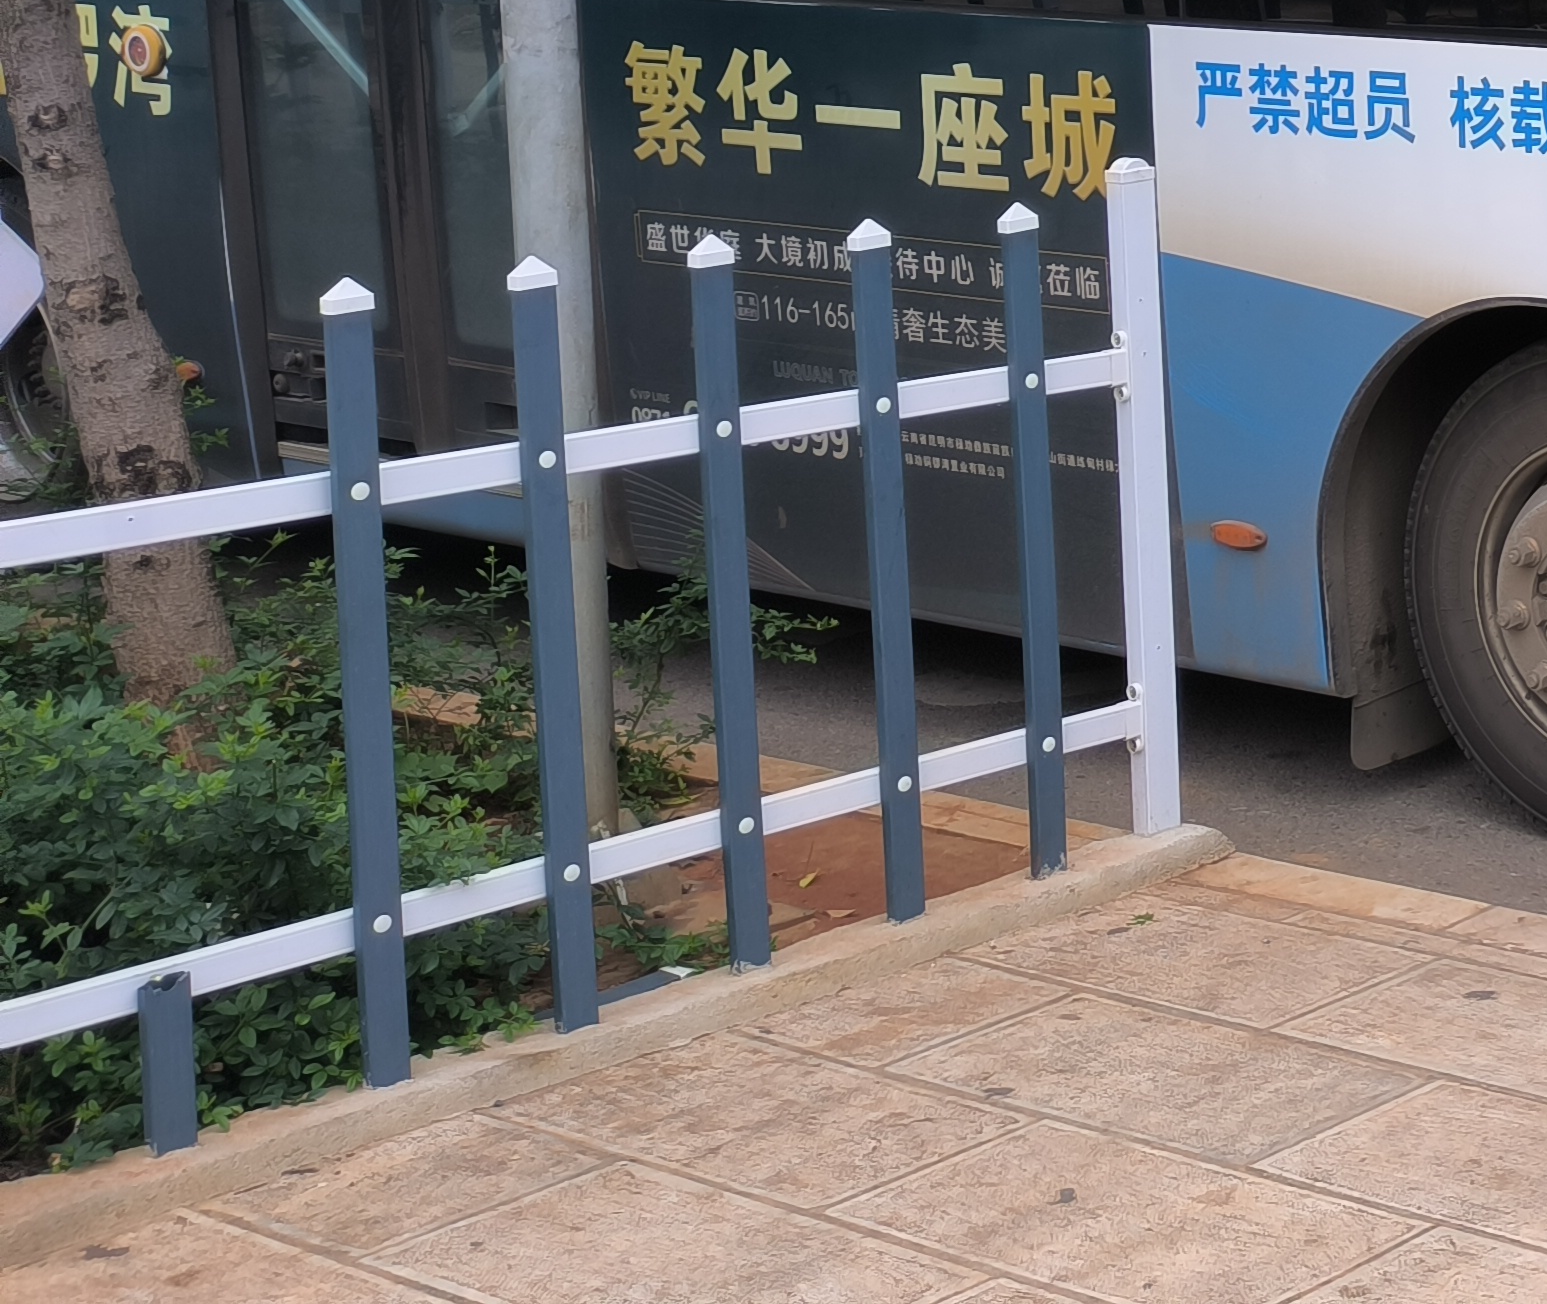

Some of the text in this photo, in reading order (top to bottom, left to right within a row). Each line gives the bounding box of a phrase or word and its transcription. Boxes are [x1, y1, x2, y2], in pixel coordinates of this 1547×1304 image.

[624, 41, 1118, 202] 繁华一座城
[1195, 61, 1417, 144] 严禁超员
[773, 360, 834, 384] LUQUAN
